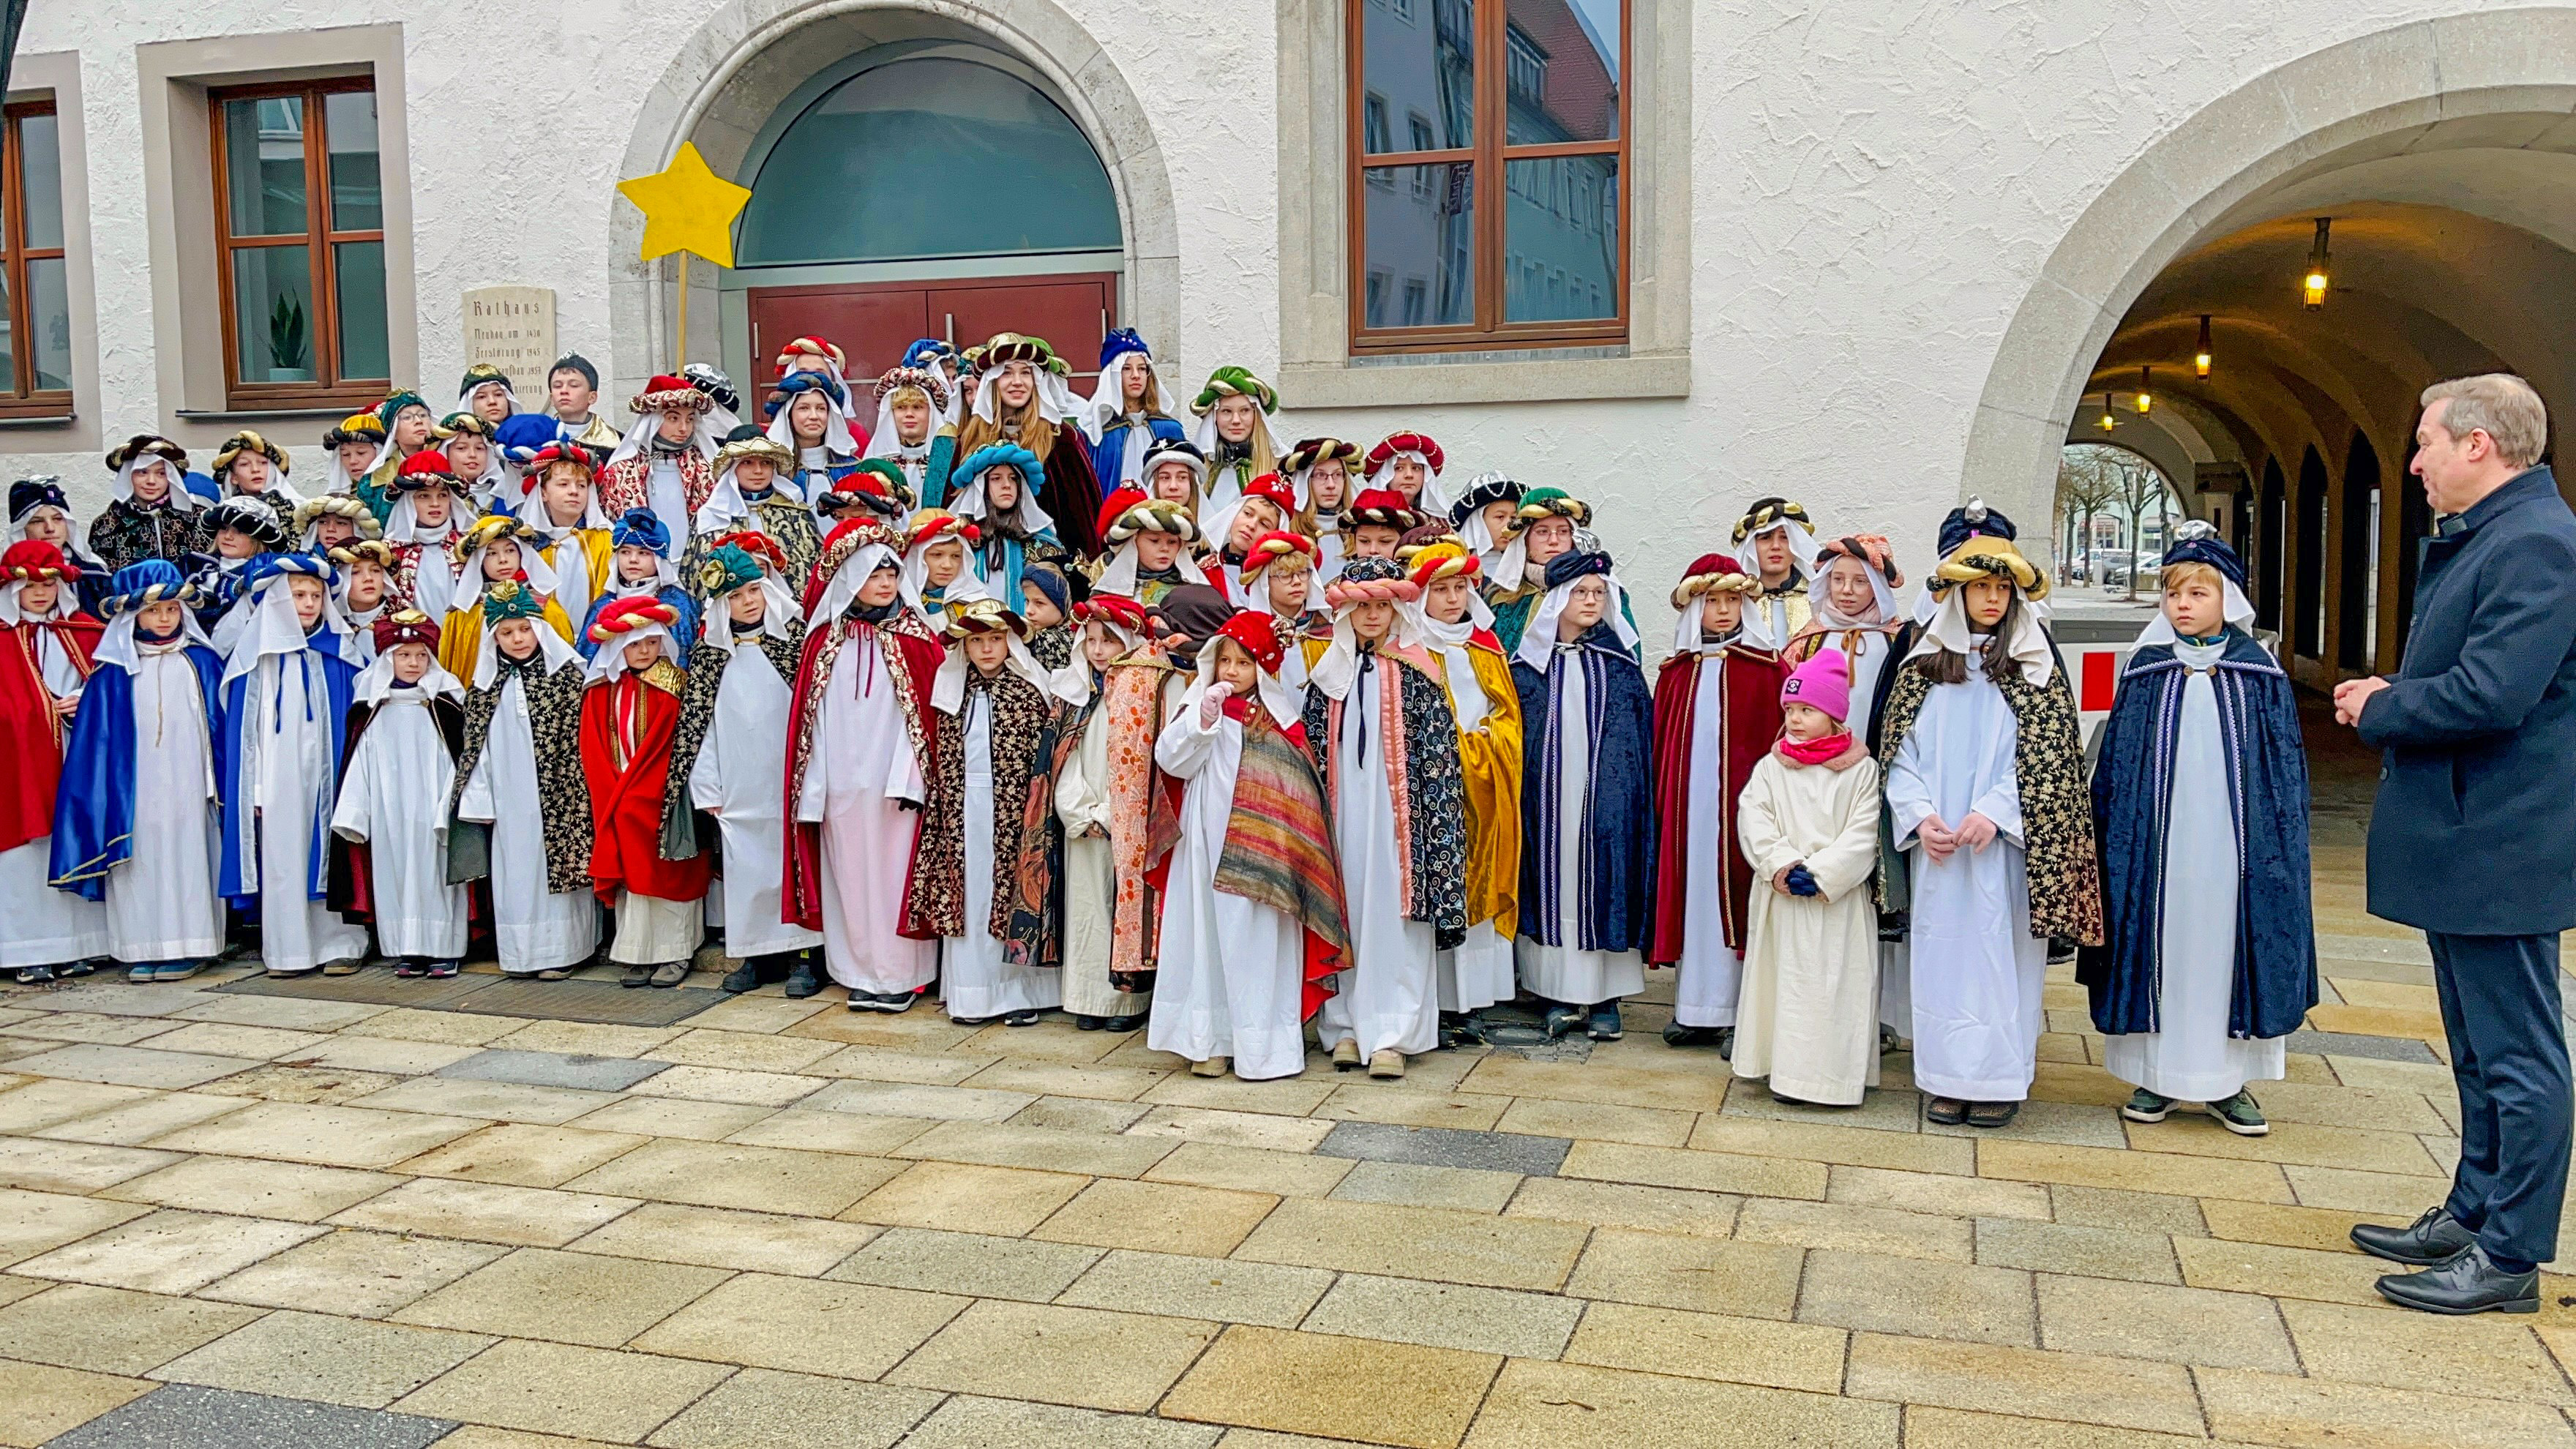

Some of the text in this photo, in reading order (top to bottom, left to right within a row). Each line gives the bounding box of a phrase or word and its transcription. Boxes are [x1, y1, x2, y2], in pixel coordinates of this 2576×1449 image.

[473, 300, 539, 316] Rathaus
[474, 328, 503, 340] Neubau
[508, 330, 519, 339] um
